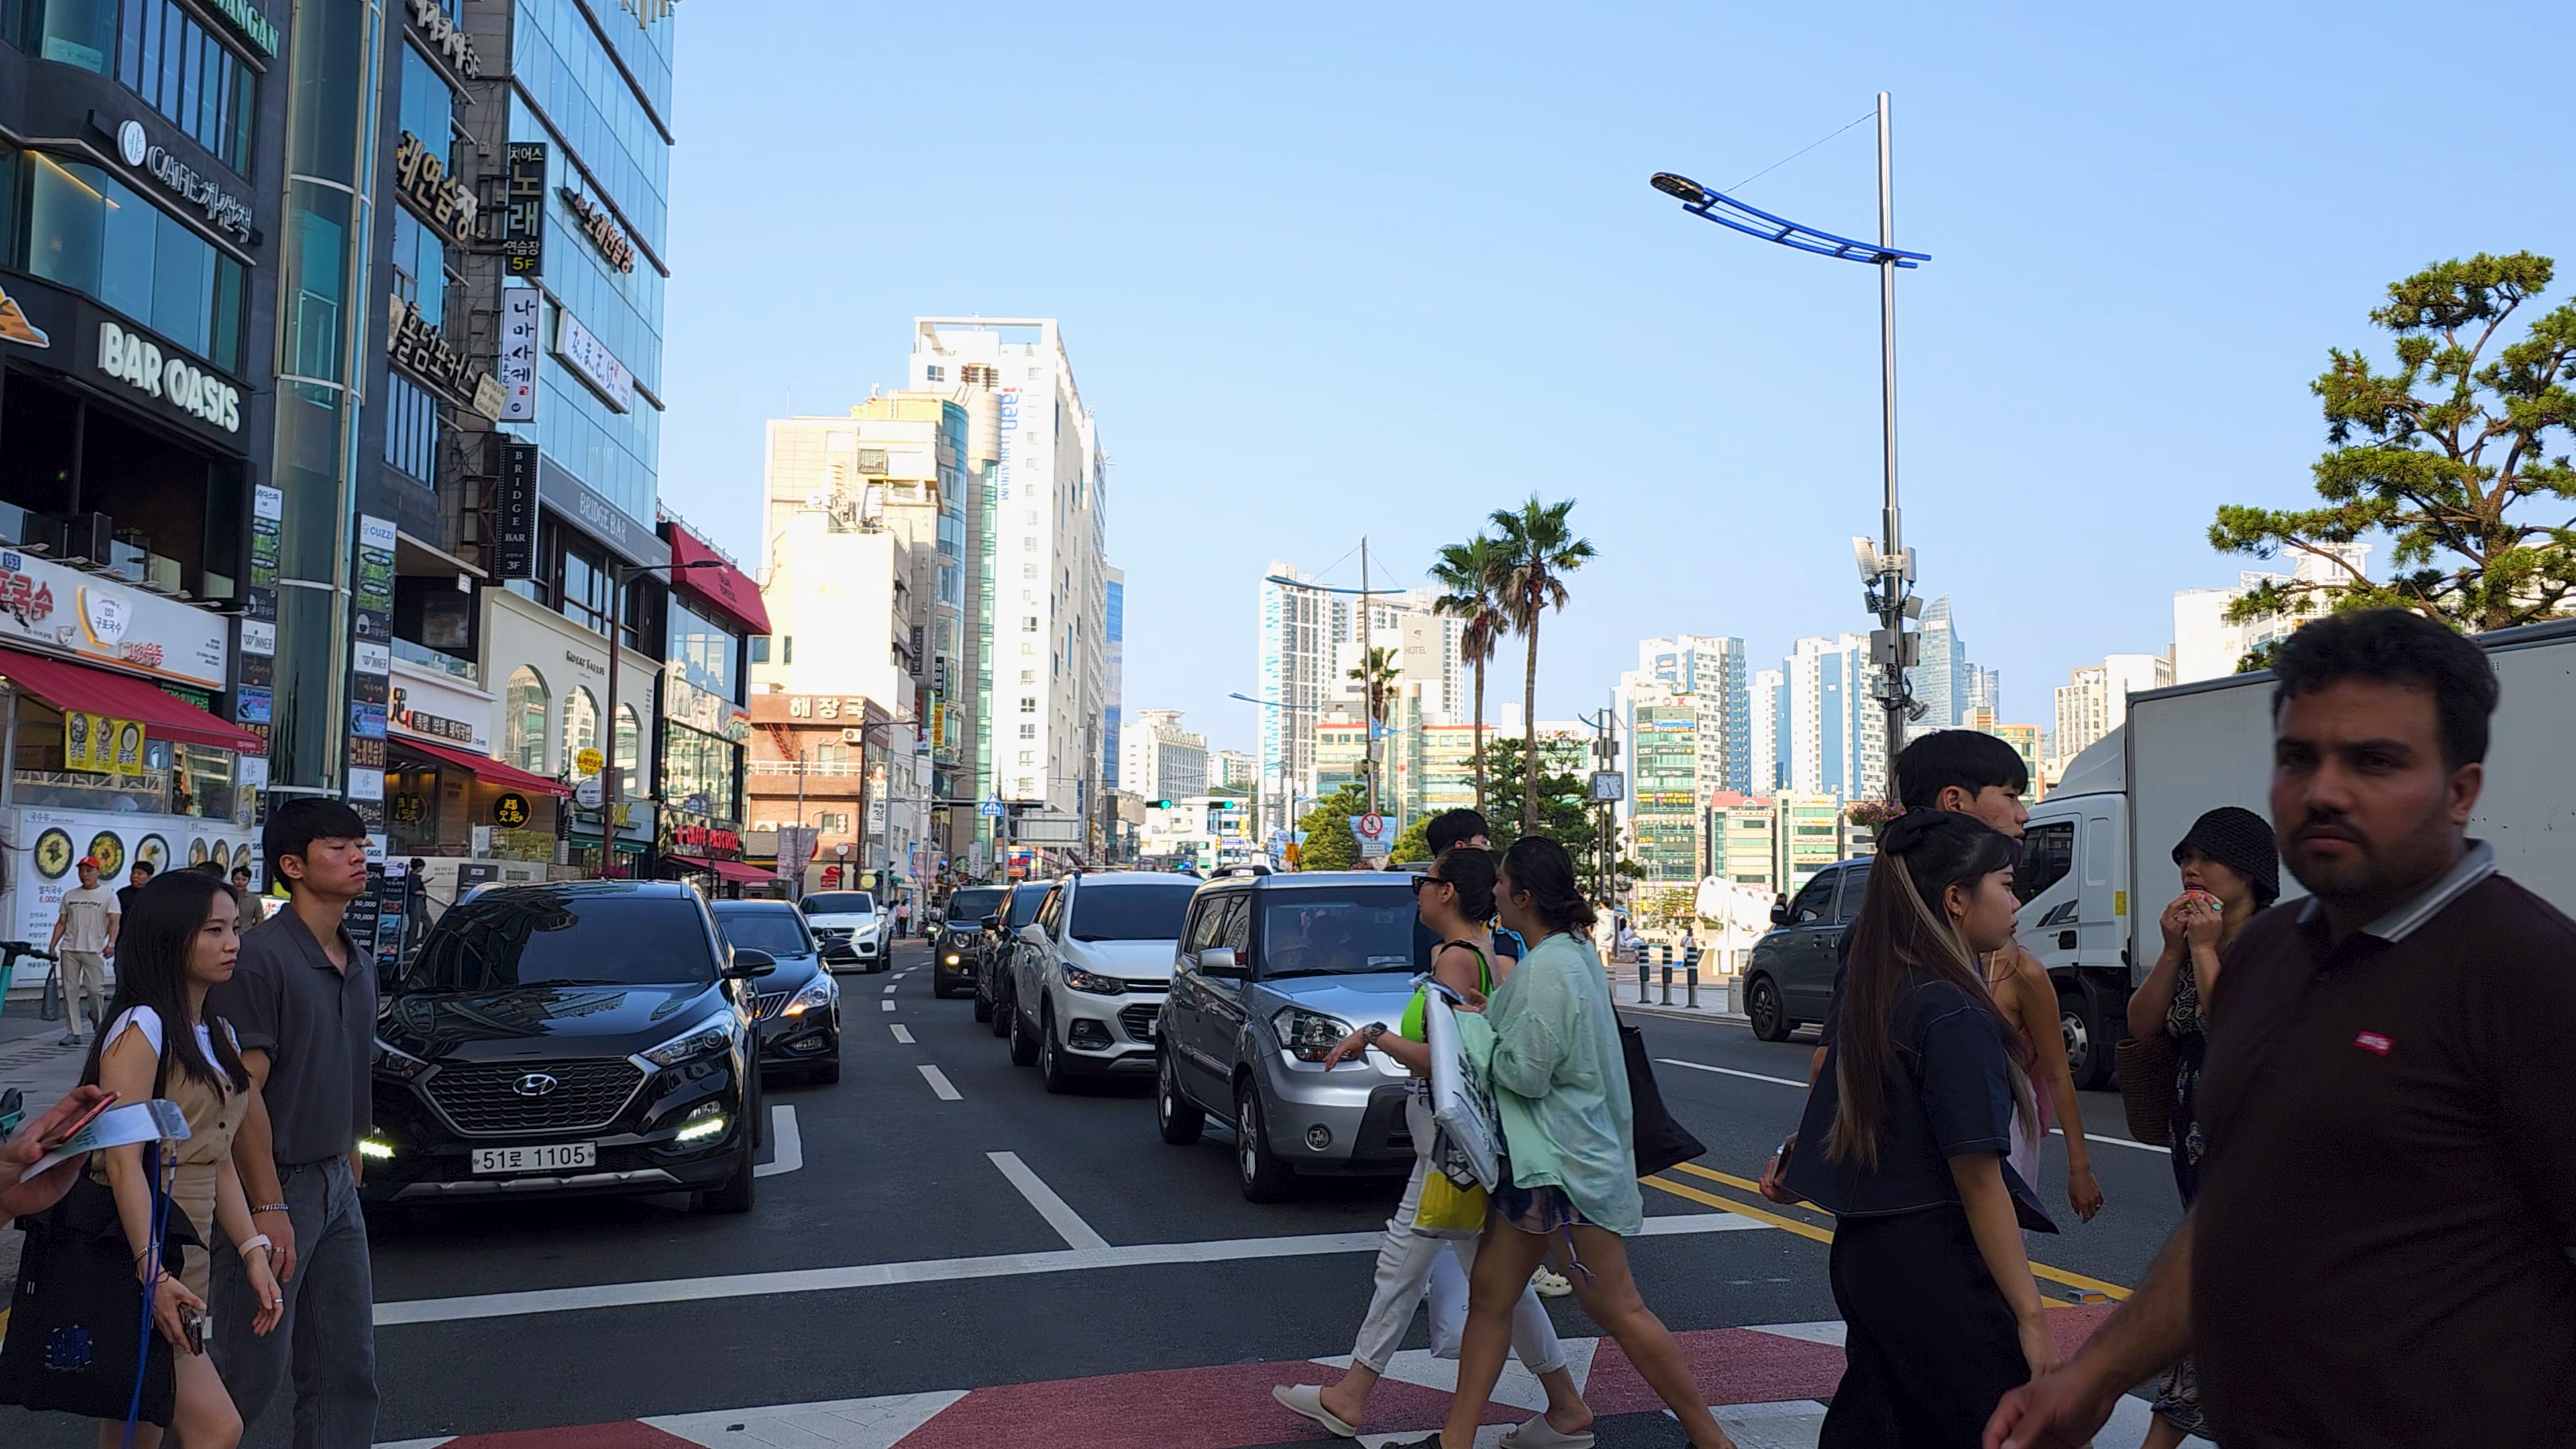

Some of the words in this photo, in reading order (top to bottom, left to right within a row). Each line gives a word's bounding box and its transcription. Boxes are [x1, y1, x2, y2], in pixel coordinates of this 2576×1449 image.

[464, 46, 482, 80] 5F
[510, 146, 544, 162] 치어스
[146, 145, 201, 203] CAFE
[582, 202, 635, 274] 노래연습장
[505, 239, 540, 256] 연습장
[512, 256, 535, 271] 5F
[98, 321, 162, 398] BAR
[163, 358, 241, 434] OASIS
[1001, 387, 1023, 431] iaan
[511, 450, 524, 527] BRIDGE
[579, 491, 610, 533] BRIDGE
[609, 512, 628, 545] BAR
[370, 526, 394, 540] CUZZI
[504, 533, 527, 543] BAR
[4, 554, 20, 570] 153
[507, 560, 522, 570] 3F
[104, 606, 115, 618] 153
[95, 616, 123, 634] 구포국수
[1405, 646, 1427, 655] HOTEL
[790, 697, 865, 719] 해장국
[416, 713, 429, 731] 족발
[38, 885, 63, 895] 멸치국수
[483, 1151, 522, 1170] 51로
[534, 1146, 585, 1167] 1105
